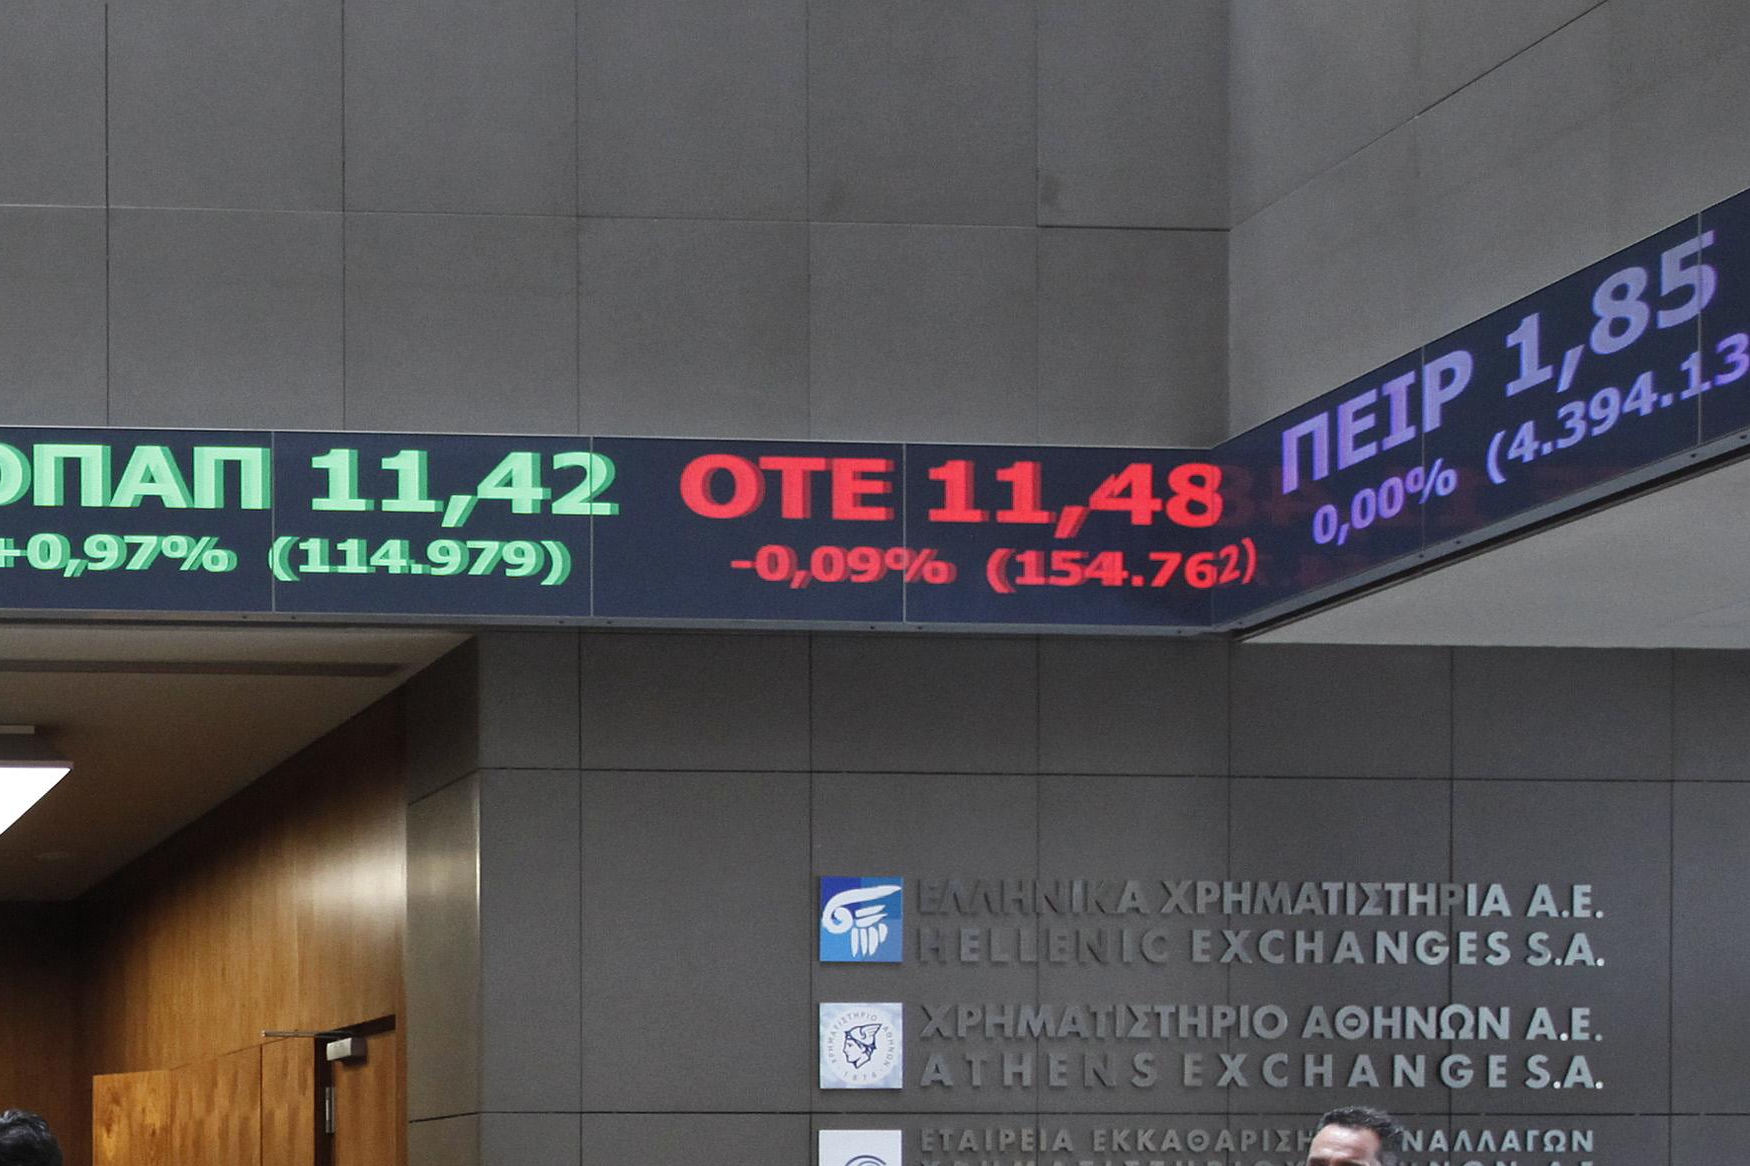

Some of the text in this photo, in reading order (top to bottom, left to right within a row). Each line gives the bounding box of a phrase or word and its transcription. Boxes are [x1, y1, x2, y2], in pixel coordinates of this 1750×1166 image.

[1281, 229, 1717, 495] ΠΕΙΡ 1,85
[1312, 332, 1750, 546] 0,00% (4.394.13
[310, 447, 620, 528] 11,42
[679, 452, 1225, 539] ΟΤΕ 11,48
[267, 536, 572, 586] (114.979)
[730, 537, 1257, 594] -0,09% (154.762)
[918, 879, 1604, 919] ΕΛΛΗΝΙΚΑ ΧΡΗΜΑΤΙΣΤΗΡΙΑ Α.Ε.
[918, 926, 1605, 967] HELLENIC EXCHANGES S.A.
[919, 1003, 1604, 1042] ΧΡΗΜΑΤΙΣΤΗΡΙΟ ΑΘΗΝΩΝ Α.Ε.
[919, 1052, 1604, 1090] ATHENS EXCHANGE S.A.
[920, 1128, 1595, 1153] ΕΤΑΙΡΕΙΑ ΕΚΚΑΘΑΡΙΣΗ ΝΑΛΛΑΓΩΝ
